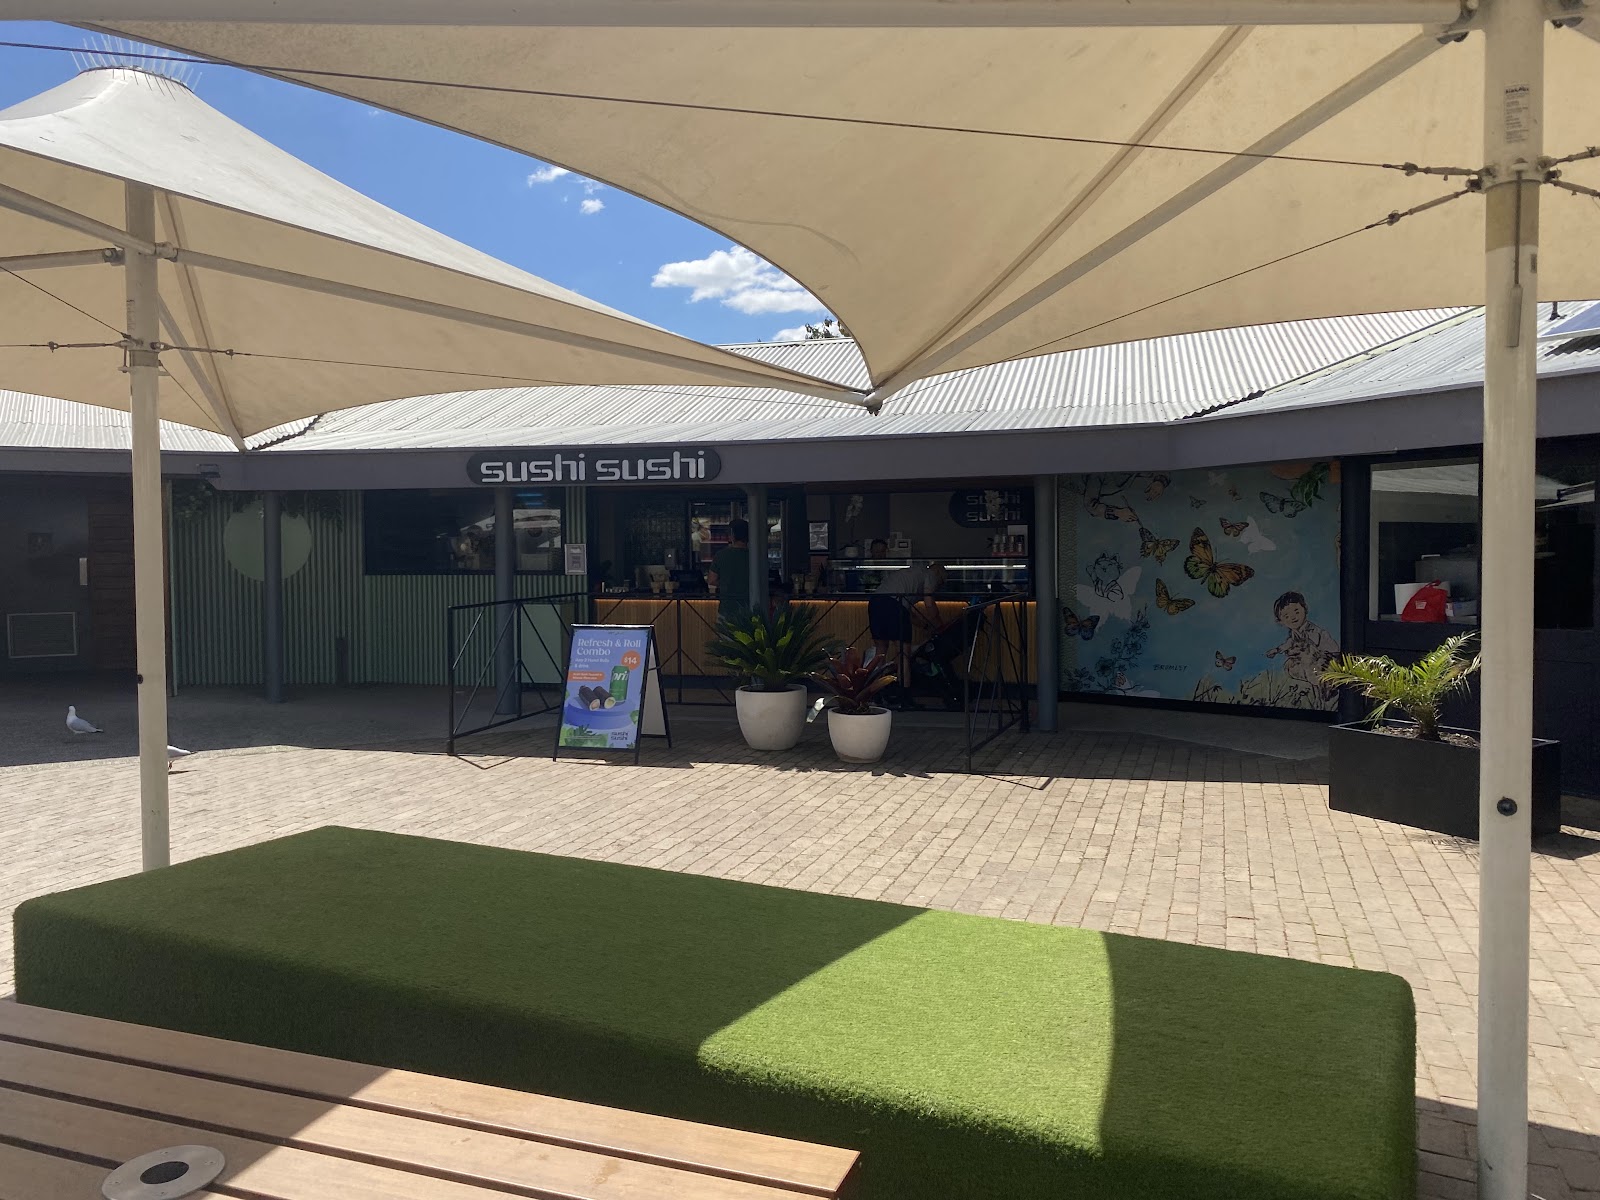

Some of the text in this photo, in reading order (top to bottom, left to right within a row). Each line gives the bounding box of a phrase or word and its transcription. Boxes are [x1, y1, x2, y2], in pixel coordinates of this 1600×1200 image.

[480, 450, 705, 483] sushi sushi
[966, 490, 1021, 505] suhi
[578, 639, 641, 648] Refresh & Roll
[577, 648, 611, 656] Combo
[623, 656, 637, 665] $14
